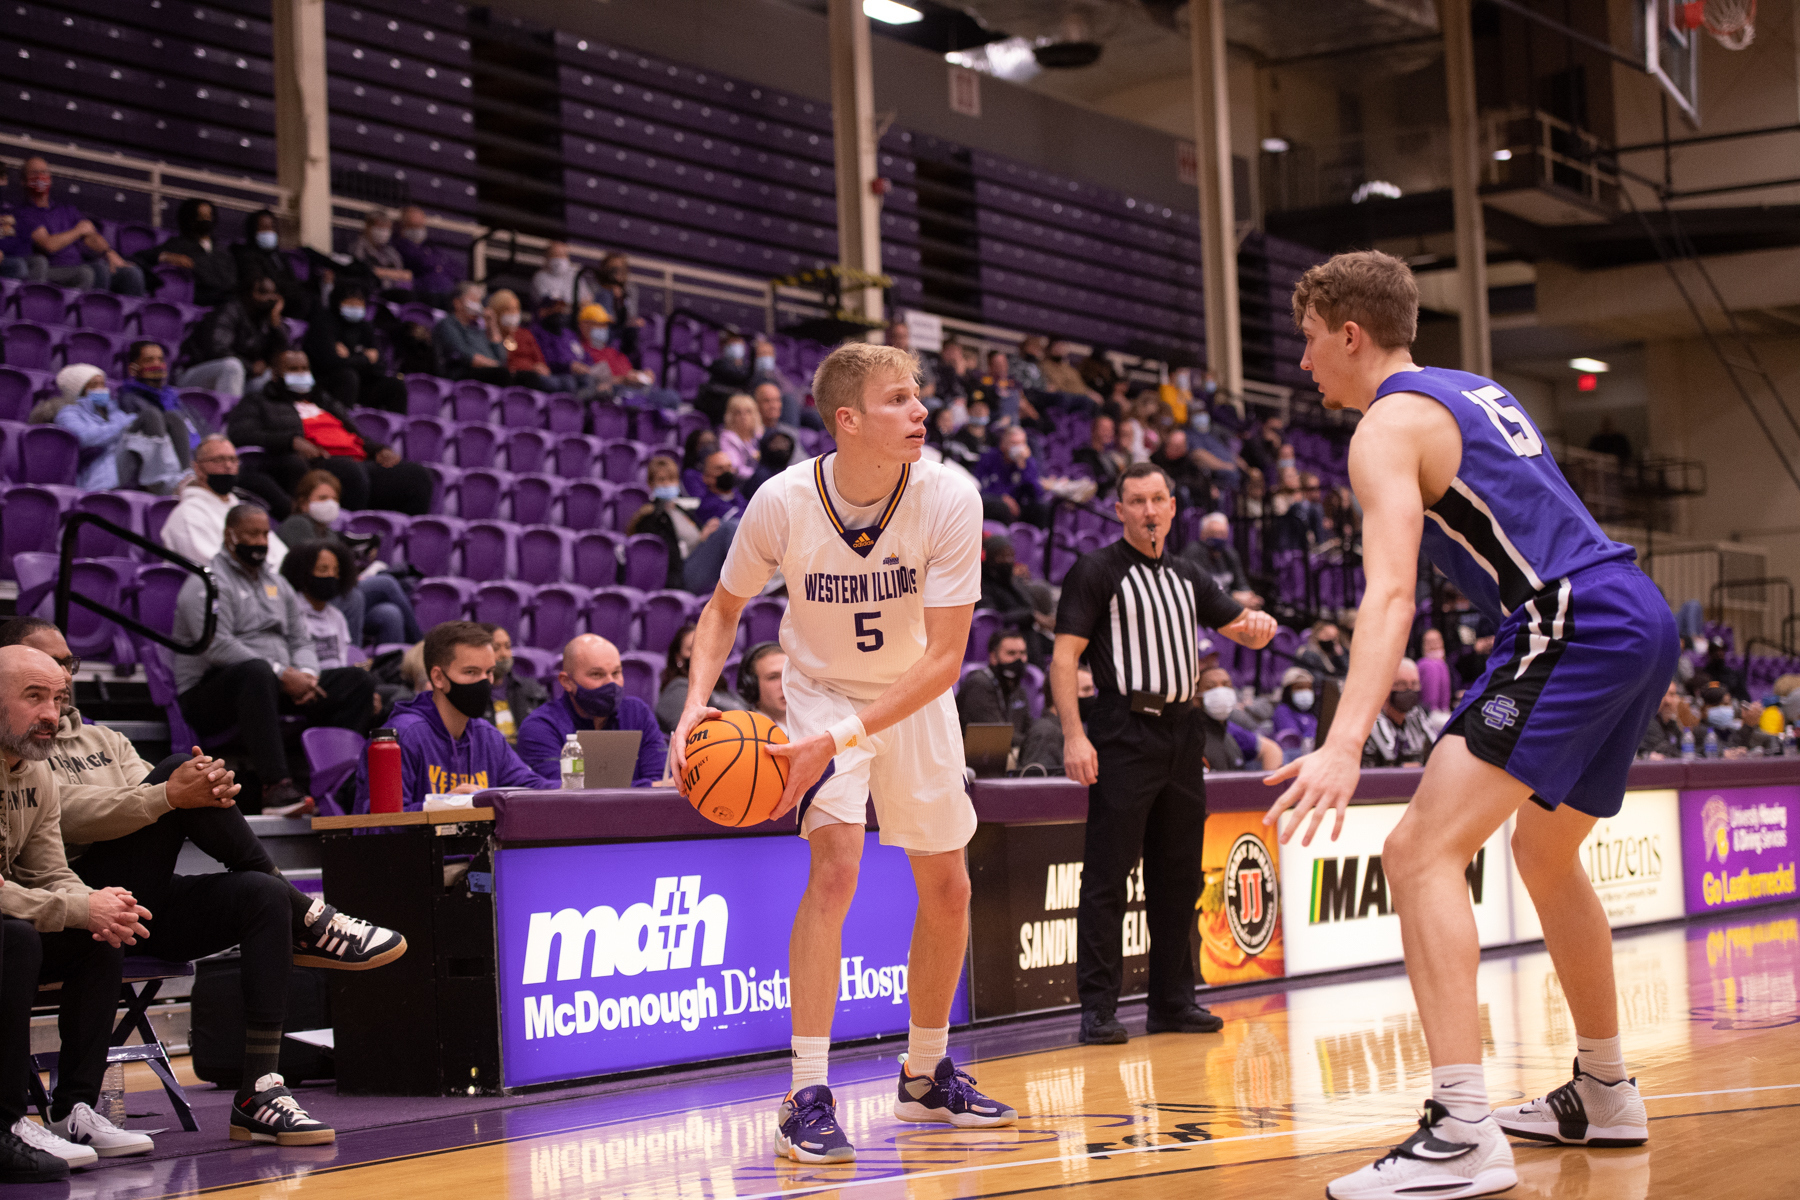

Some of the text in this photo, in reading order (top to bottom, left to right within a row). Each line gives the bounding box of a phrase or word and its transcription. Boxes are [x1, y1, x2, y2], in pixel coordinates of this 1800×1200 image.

[1461, 385, 1544, 458] 15
[852, 540, 875, 548] adidas
[804, 572, 869, 604] WESTERN
[853, 610, 884, 653] 5
[1587, 825, 1662, 883] itizens
[1703, 871, 1722, 906] Go
[523, 977, 718, 1040] McDonough
[839, 954, 908, 1005] Hosp
